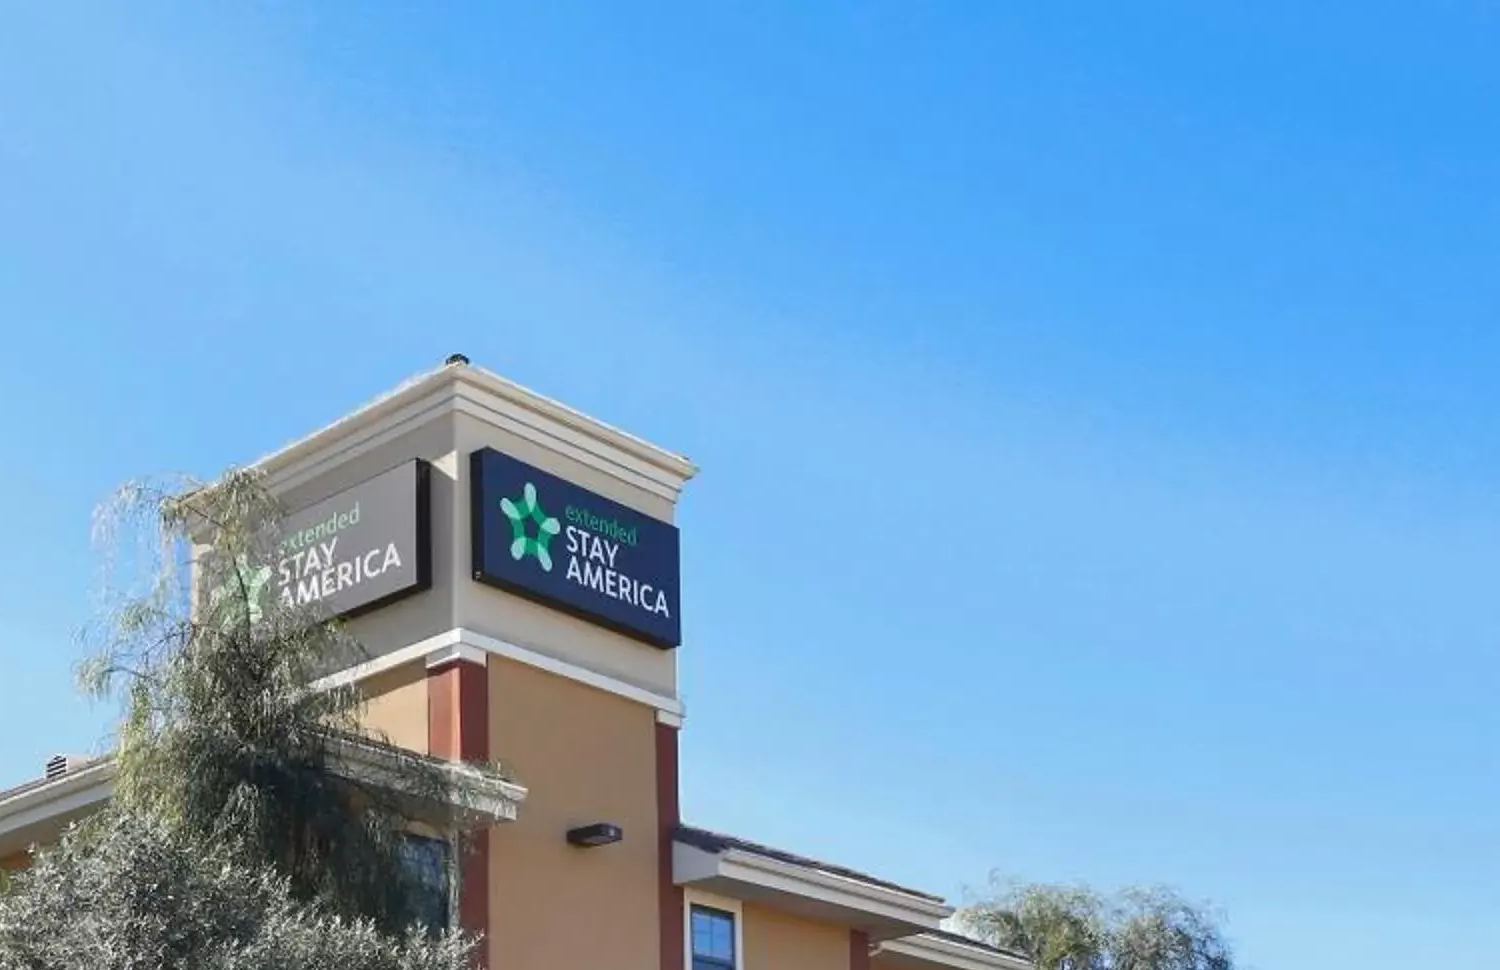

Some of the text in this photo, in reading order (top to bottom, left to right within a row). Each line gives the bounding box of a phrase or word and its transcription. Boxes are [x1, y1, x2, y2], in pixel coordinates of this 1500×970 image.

[565, 505, 637, 545] extended
[565, 525, 619, 568] STAY
[279, 536, 338, 586] STAY
[280, 541, 402, 608] AMERICA
[566, 555, 669, 618] AMERICA
